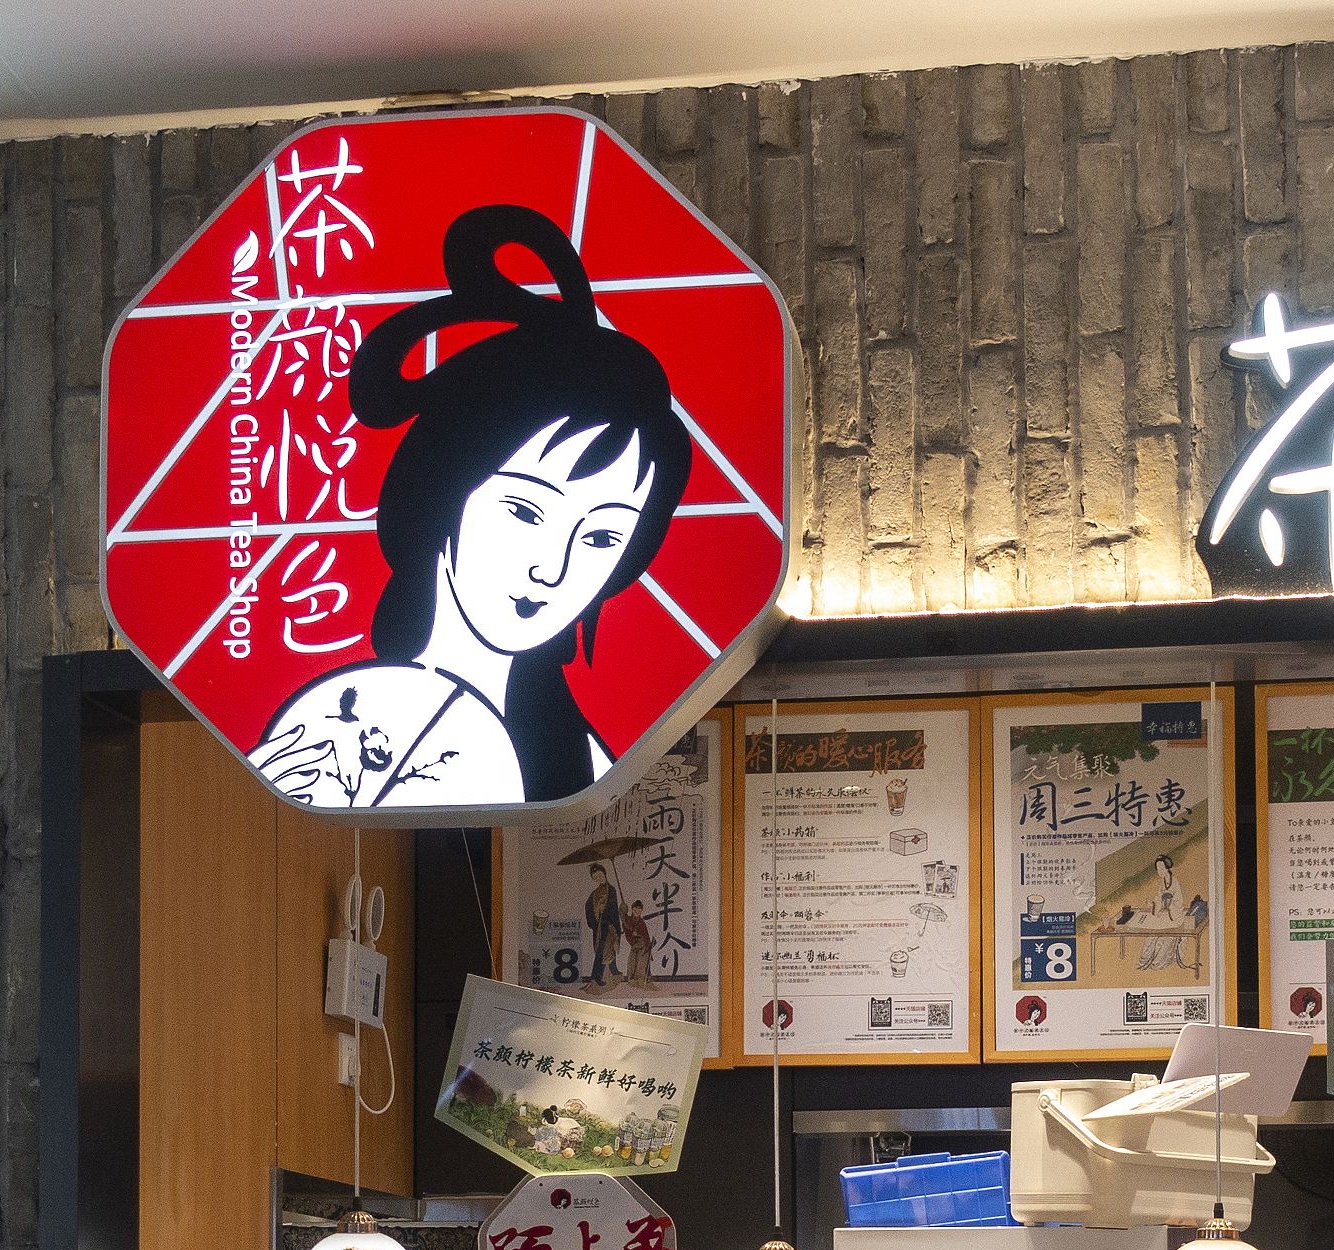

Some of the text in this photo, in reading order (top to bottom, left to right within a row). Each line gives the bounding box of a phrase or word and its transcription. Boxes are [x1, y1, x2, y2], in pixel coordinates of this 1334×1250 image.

[222, 274, 260, 660] Modern China Tea Shop
[1019, 778, 1193, 831] 周三特惠
[553, 948, 579, 983] 8
[1046, 942, 1073, 979] 8
[472, 1039, 679, 1102] 茶颜柠檬茶新鲜好喝哟
